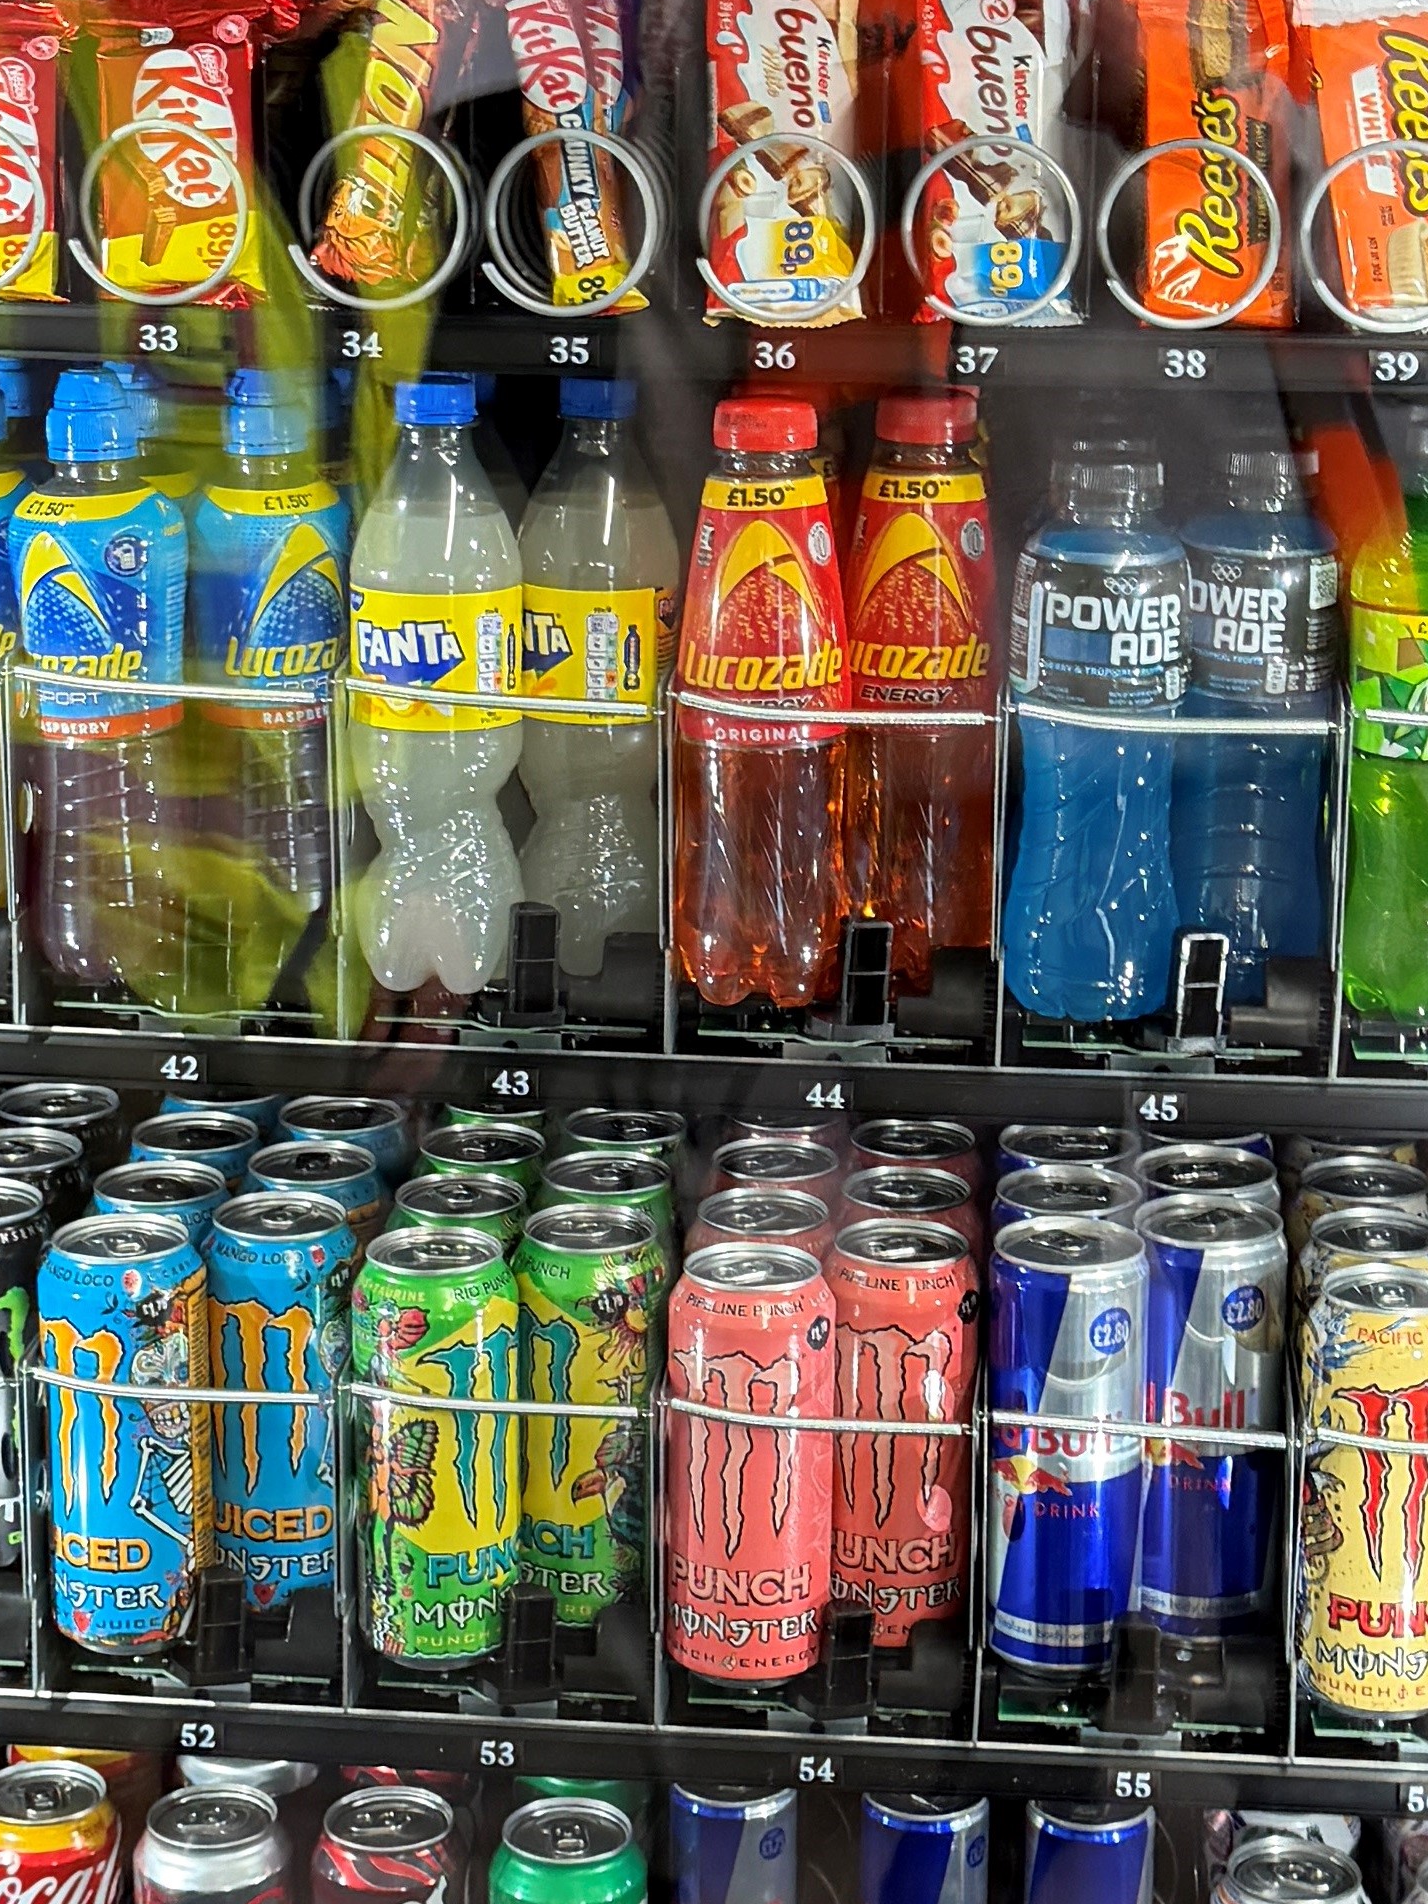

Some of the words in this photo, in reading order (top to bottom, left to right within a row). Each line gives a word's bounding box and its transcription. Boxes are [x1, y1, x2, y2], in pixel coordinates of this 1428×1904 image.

[507, 0, 587, 109] KitKat
[774, 8, 816, 129] bueno
[137, 323, 179, 352] 33
[340, 330, 384, 360] 34
[548, 335, 591, 366] 35
[753, 341, 797, 371] 36
[954, 346, 1000, 377] 37
[1163, 349, 1208, 380] 38
[1374, 351, 1420, 382] 39
[1045, 591, 1182, 632] POWER
[357, 619, 464, 667] FANTA
[1109, 627, 1182, 666] ADE
[1213, 618, 1286, 654] ADE
[684, 638, 844, 693] Lucozade
[860, 683, 954, 705] ENERGY
[159, 1055, 201, 1082] 42
[491, 1071, 531, 1096] 43
[805, 1083, 846, 1110] 44
[1138, 1095, 1180, 1123] 45
[73, 1267, 114, 1288] LOCO
[1225, 1302, 1263, 1324] £2.80
[1356, 1326, 1424, 1346] PACIFIC
[672, 1551, 811, 1606] PUNCH
[1317, 1671, 1392, 1698] PUNCH
[179, 1724, 217, 1749] 52
[478, 1741, 516, 1768] 53
[797, 1756, 836, 1784] 54
[1114, 1771, 1153, 1799] 55
